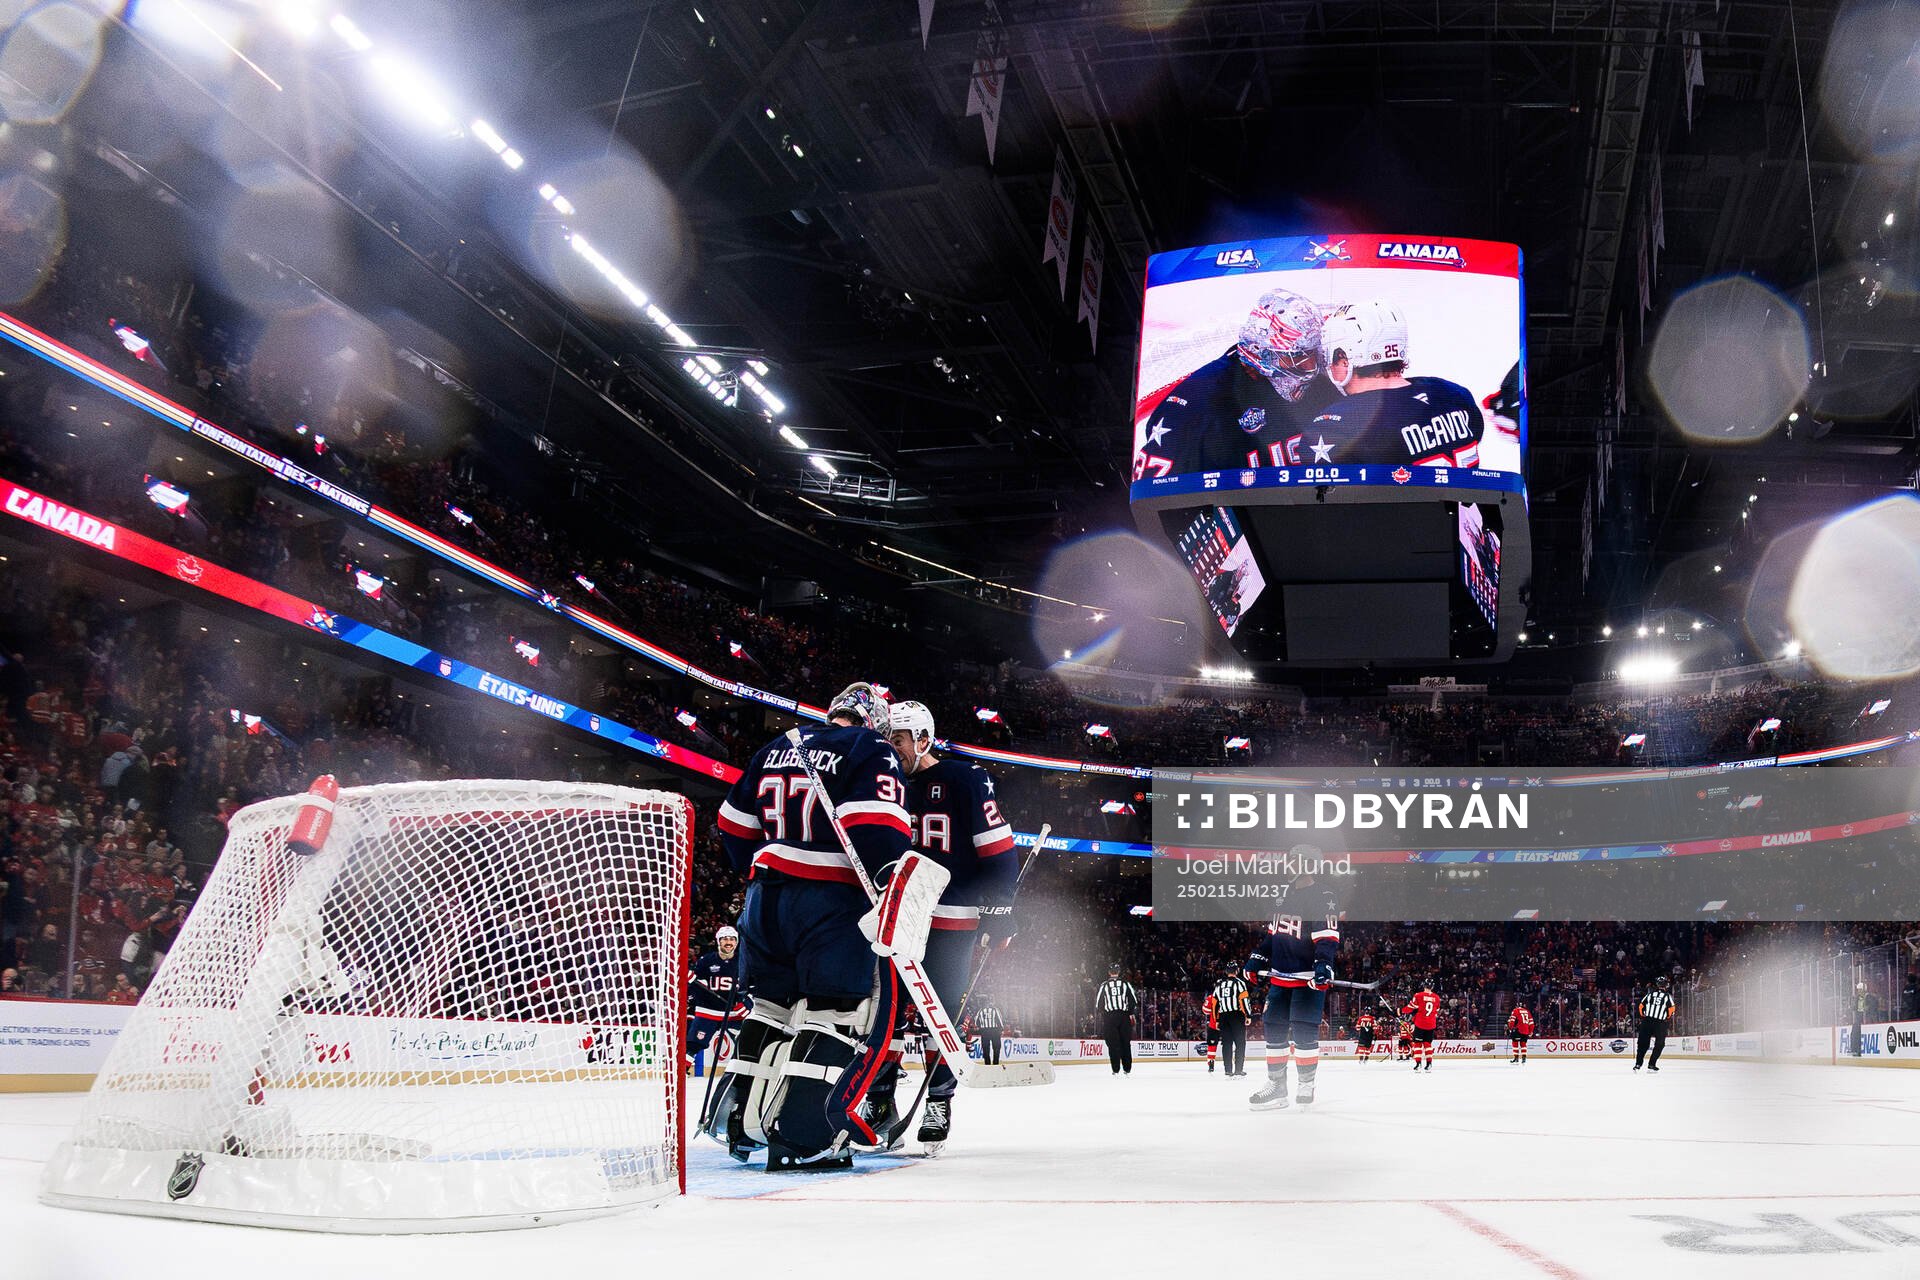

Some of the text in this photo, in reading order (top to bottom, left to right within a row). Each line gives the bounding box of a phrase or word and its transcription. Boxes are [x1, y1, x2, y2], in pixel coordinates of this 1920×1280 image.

[1216, 249, 1254, 266] USA
[1378, 243, 1460, 260] CANADA
[1384, 344, 1399, 358] 25
[193, 419, 283, 470] CONFRONTATION
[282, 461, 306, 484] DES
[318, 481, 368, 515] NATIONS
[1305, 468, 1339, 479] 00.0
[1279, 470, 1290, 483] 3
[1359, 469, 1367, 481] 1
[1204, 479, 1218, 488] 23
[5, 488, 116, 550] CANADA
[478, 671, 566, 719] ÉTATS-UNIS
[687, 666, 738, 694] CONFRONTATION
[762, 692, 797, 710] NATIONS
[1744, 757, 1777, 768] NATIONS
[1082, 764, 1137, 776] CONFRONTATION
[1137, 768, 1151, 776] DES
[1159, 771, 1192, 780] NATIONS
[1413, 778, 1421, 787] 3
[931, 785, 941, 799] A
[757, 775, 819, 842] 37
[983, 800, 1006, 827] 2
[1761, 831, 1812, 847] CANADA
[1514, 850, 1580, 863] ÉTATS-UNIS
[979, 905, 1013, 915] AUER
[709, 976, 733, 991] US
[904, 960, 959, 1053] TRUE
[1425, 1002, 1434, 1017] 9
[1137, 1042, 1155, 1051] TRULY
[1158, 1042, 1179, 1051] TRULY
[1560, 1041, 1604, 1052] ROGERS
[1898, 1032, 1920, 1048] NHL
[1012, 1042, 1040, 1055] FANDUEL
[1079, 1040, 1104, 1058] TYLENOL
[1437, 1041, 1477, 1054] Hortons
